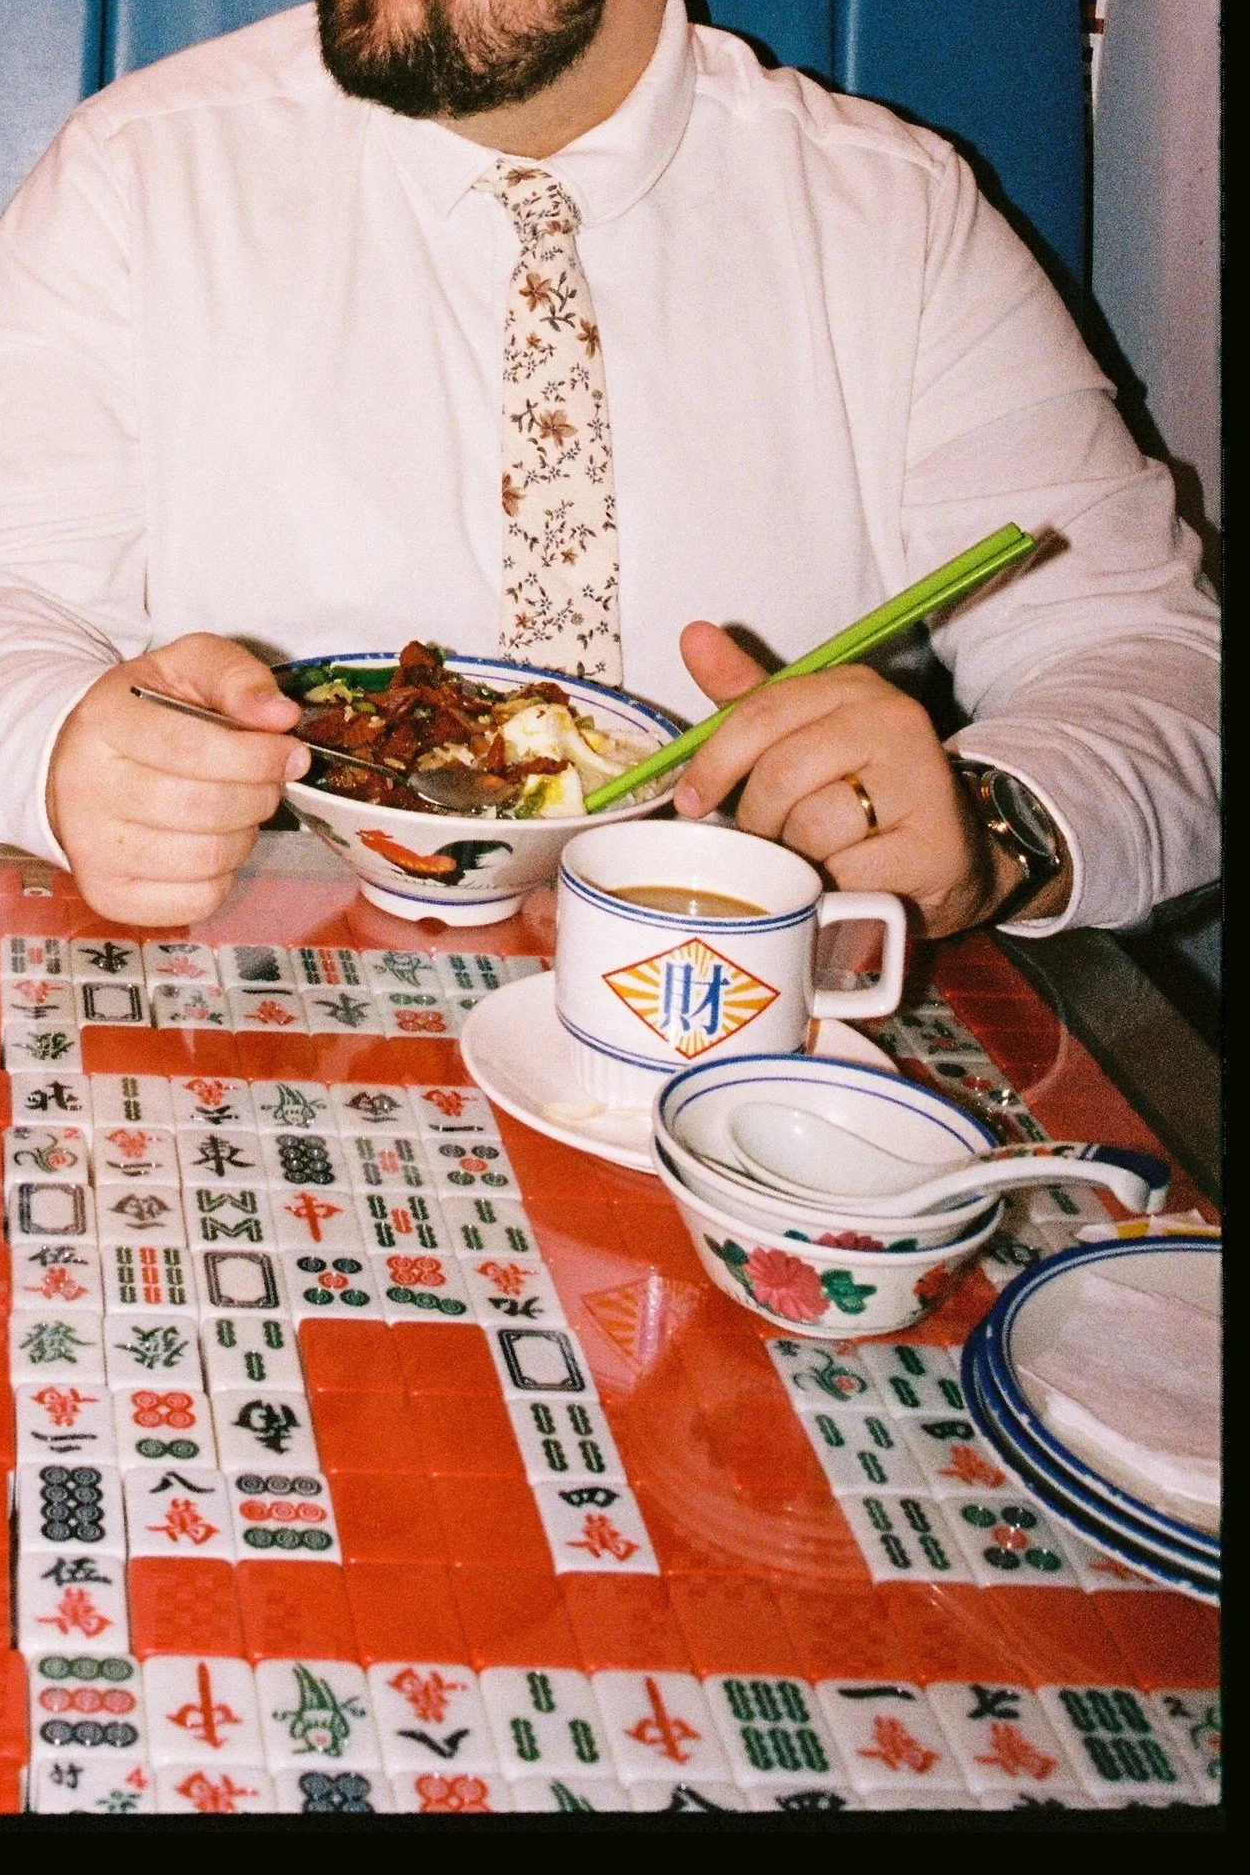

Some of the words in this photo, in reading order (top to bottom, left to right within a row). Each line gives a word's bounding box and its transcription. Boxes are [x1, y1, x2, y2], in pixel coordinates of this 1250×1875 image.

[661, 961, 731, 1036] 財
[25, 1080, 82, 1112] 北
[192, 1134, 255, 1178] 東
[284, 1191, 343, 1243] 中
[147, 1470, 219, 1545] 八萬
[558, 1485, 641, 1562] 四萬
[37, 1556, 113, 1638] 伍萬
[166, 1660, 242, 1749] 中
[387, 1667, 469, 1760] 八萬
[625, 1676, 701, 1765] 中
[837, 1686, 940, 1775] 一萬
